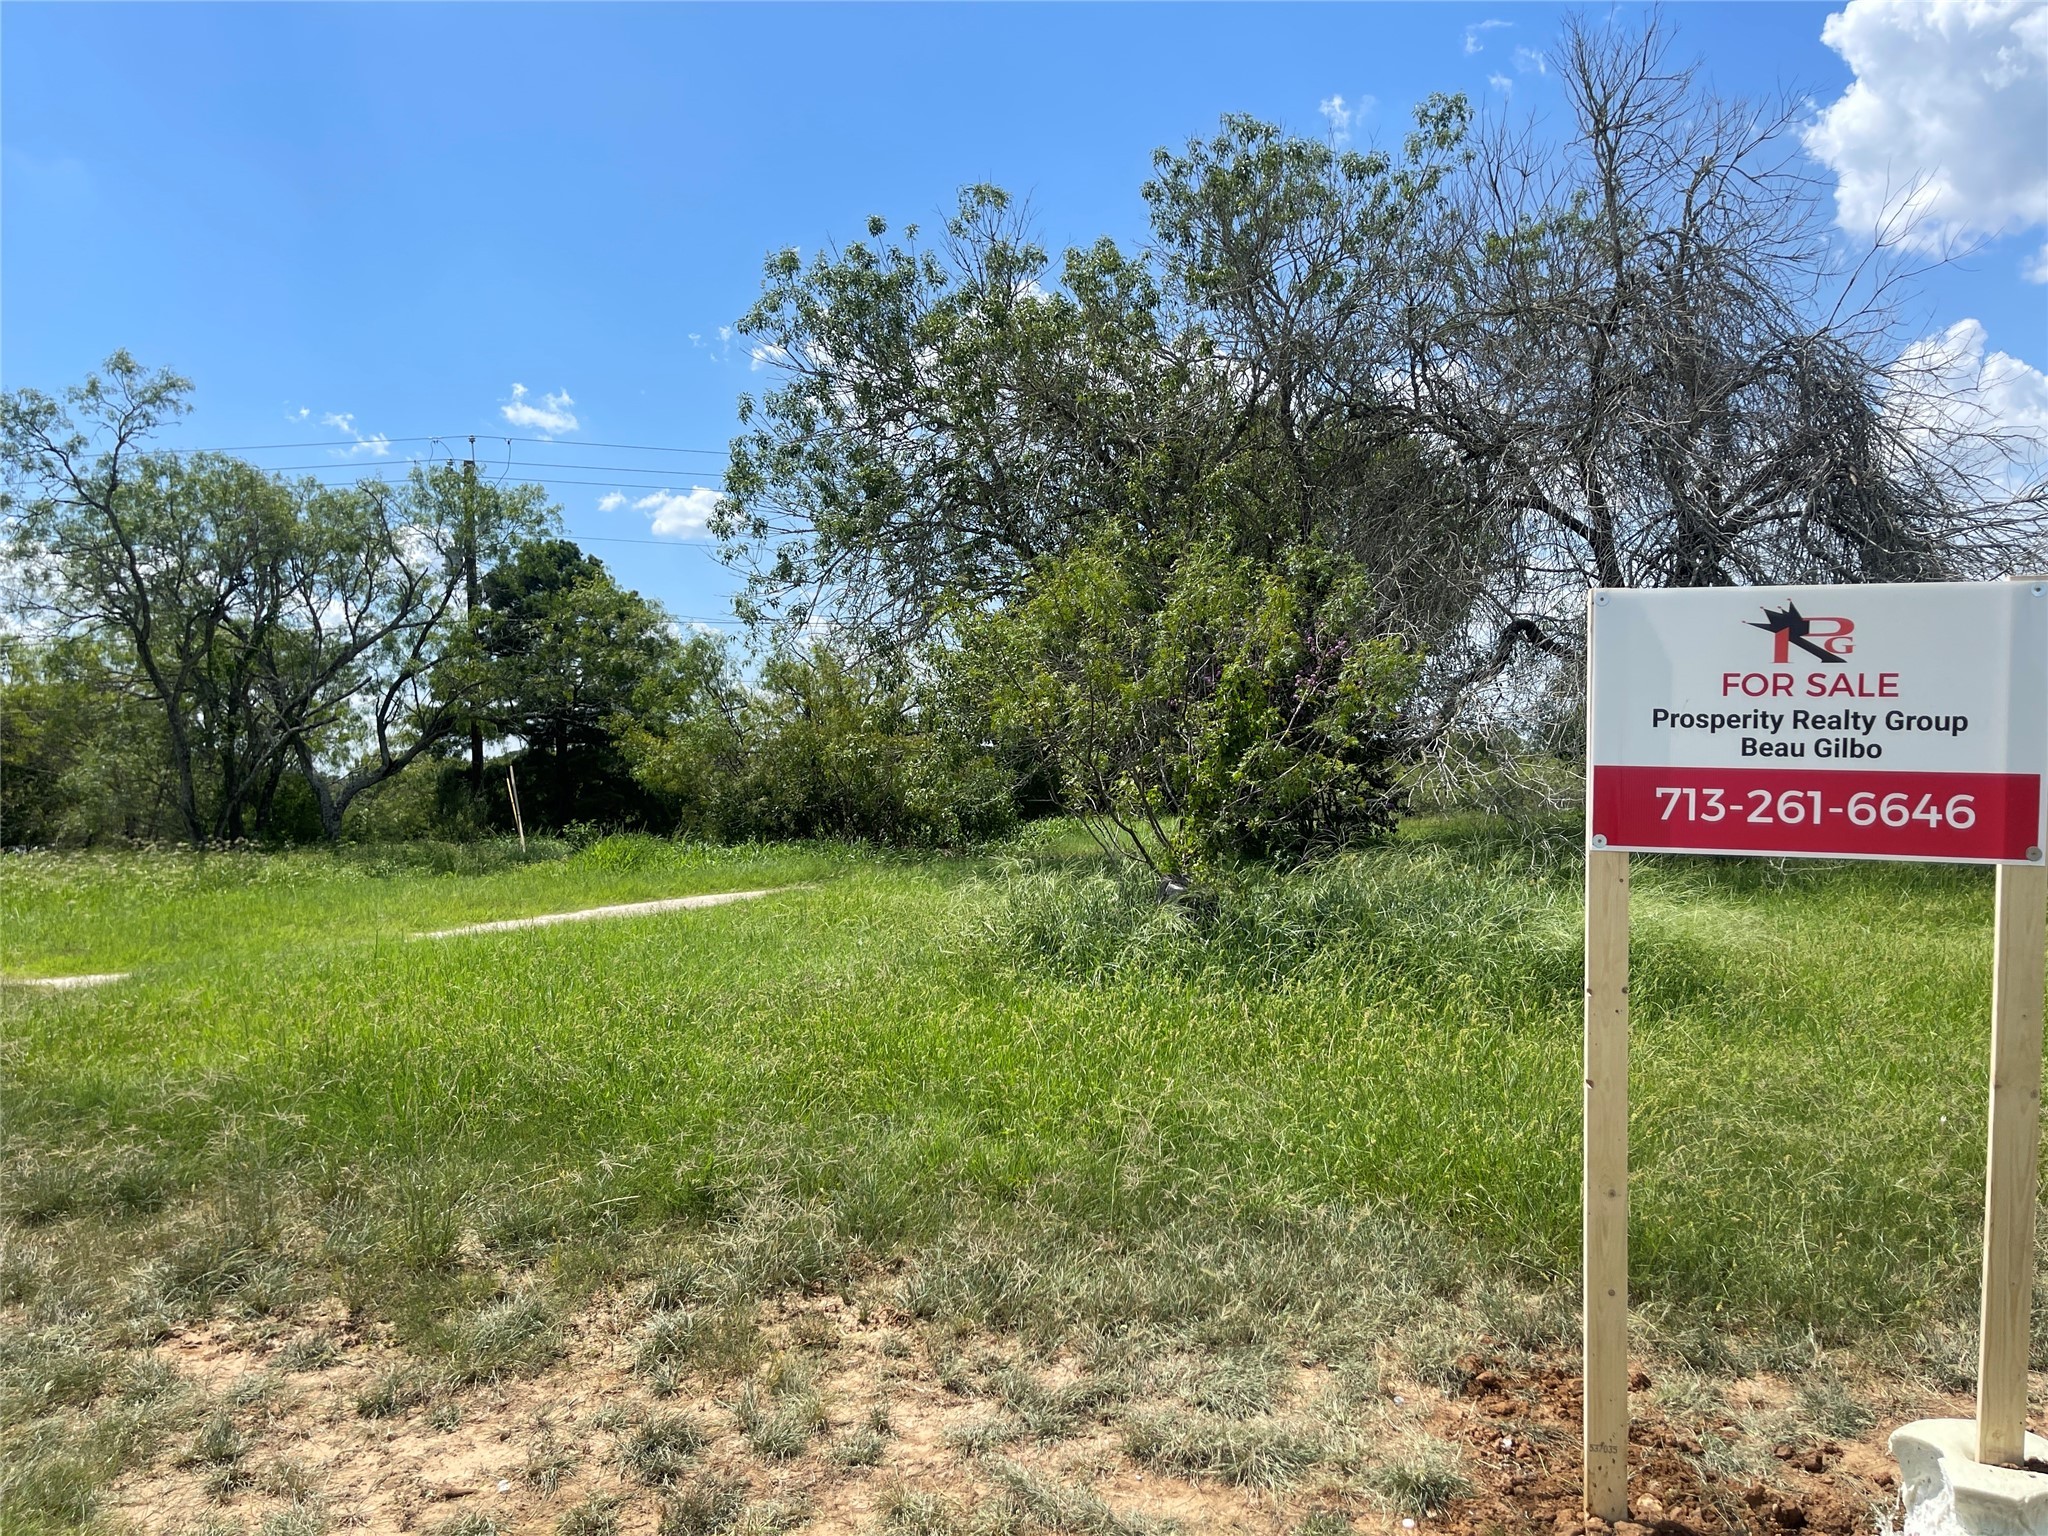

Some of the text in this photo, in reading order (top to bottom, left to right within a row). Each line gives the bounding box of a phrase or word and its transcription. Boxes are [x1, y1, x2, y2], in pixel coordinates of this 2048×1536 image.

[1721, 671, 1900, 698] FOR SALE
[1652, 708, 1969, 737] Prosperity Realty Group
[1741, 737, 1883, 759] Beau Gilbo
[1655, 787, 1976, 829] 713-261-6646
